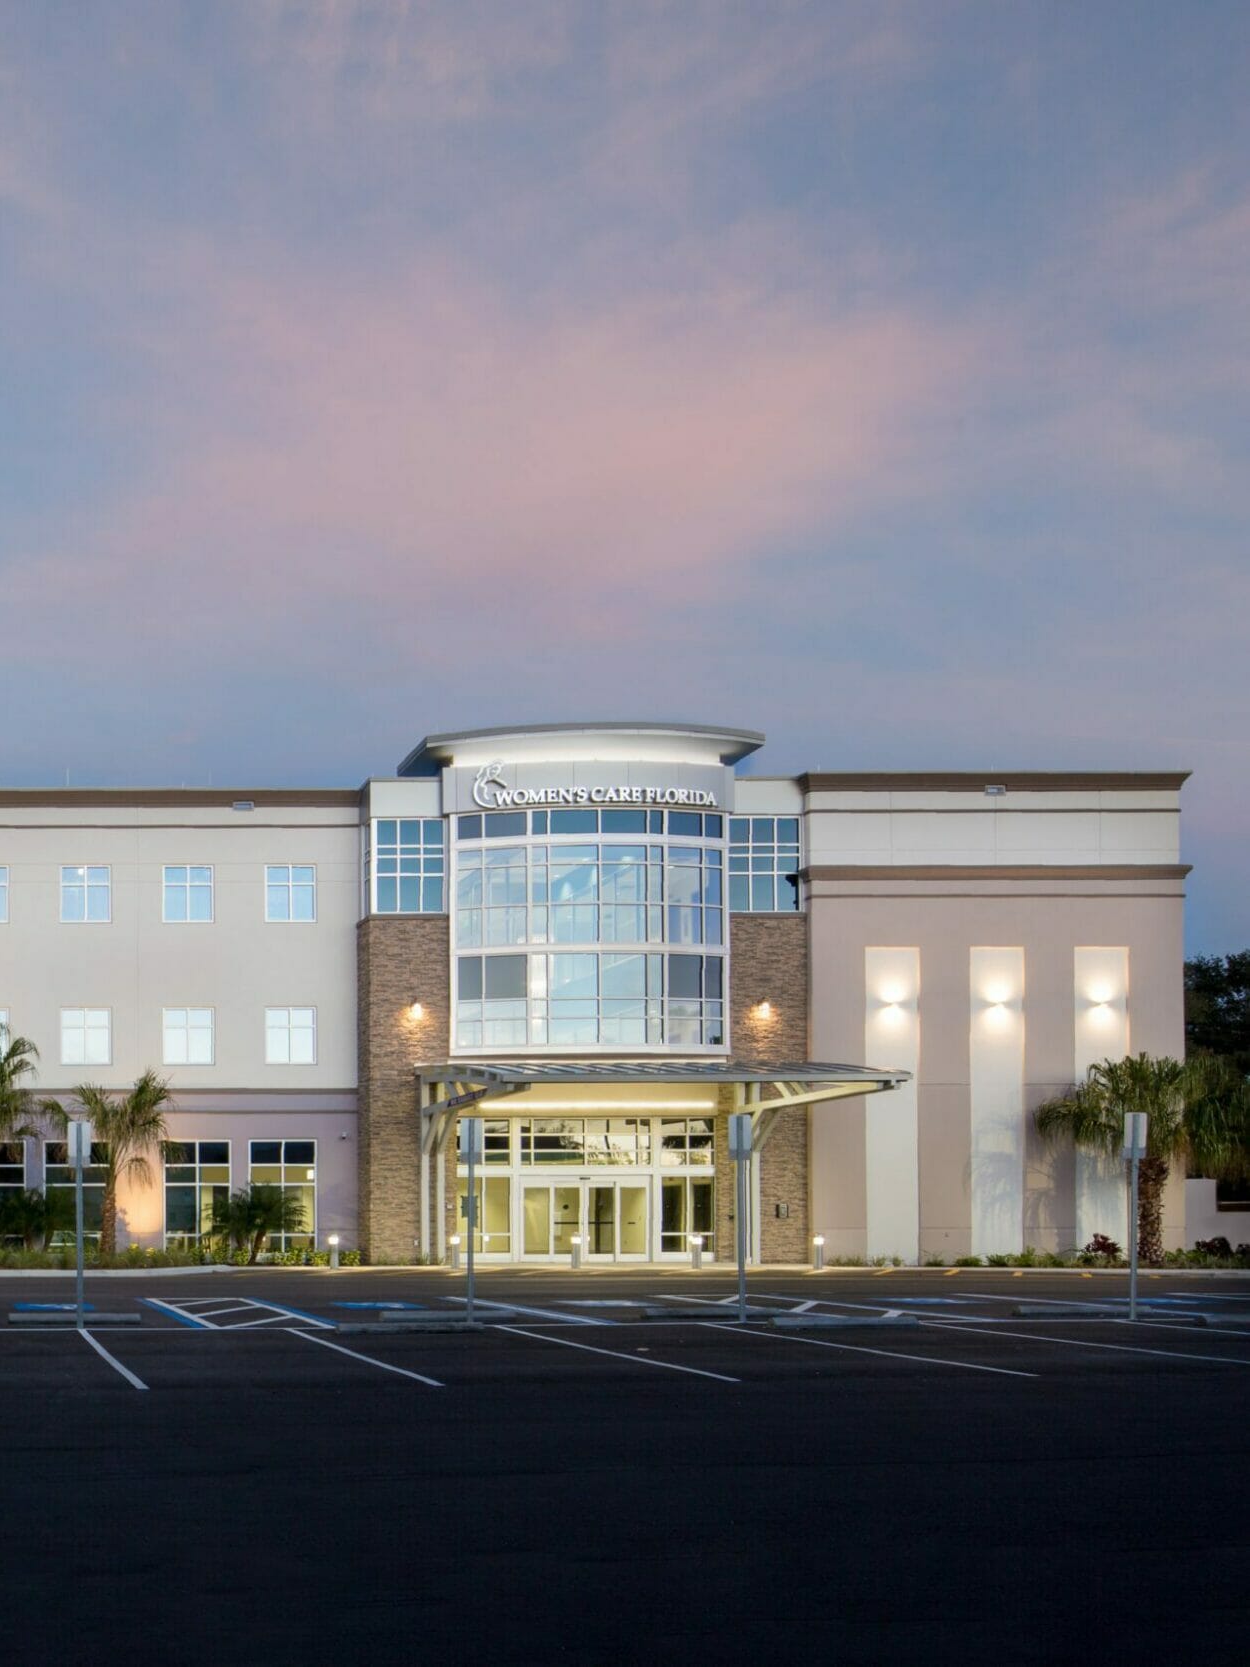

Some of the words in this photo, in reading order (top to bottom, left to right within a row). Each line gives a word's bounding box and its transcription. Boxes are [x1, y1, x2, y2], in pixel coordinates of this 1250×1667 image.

[495, 787, 587, 806] WOMEN'S
[591, 786, 641, 802] CARE
[645, 786, 717, 806] FLORIDA
